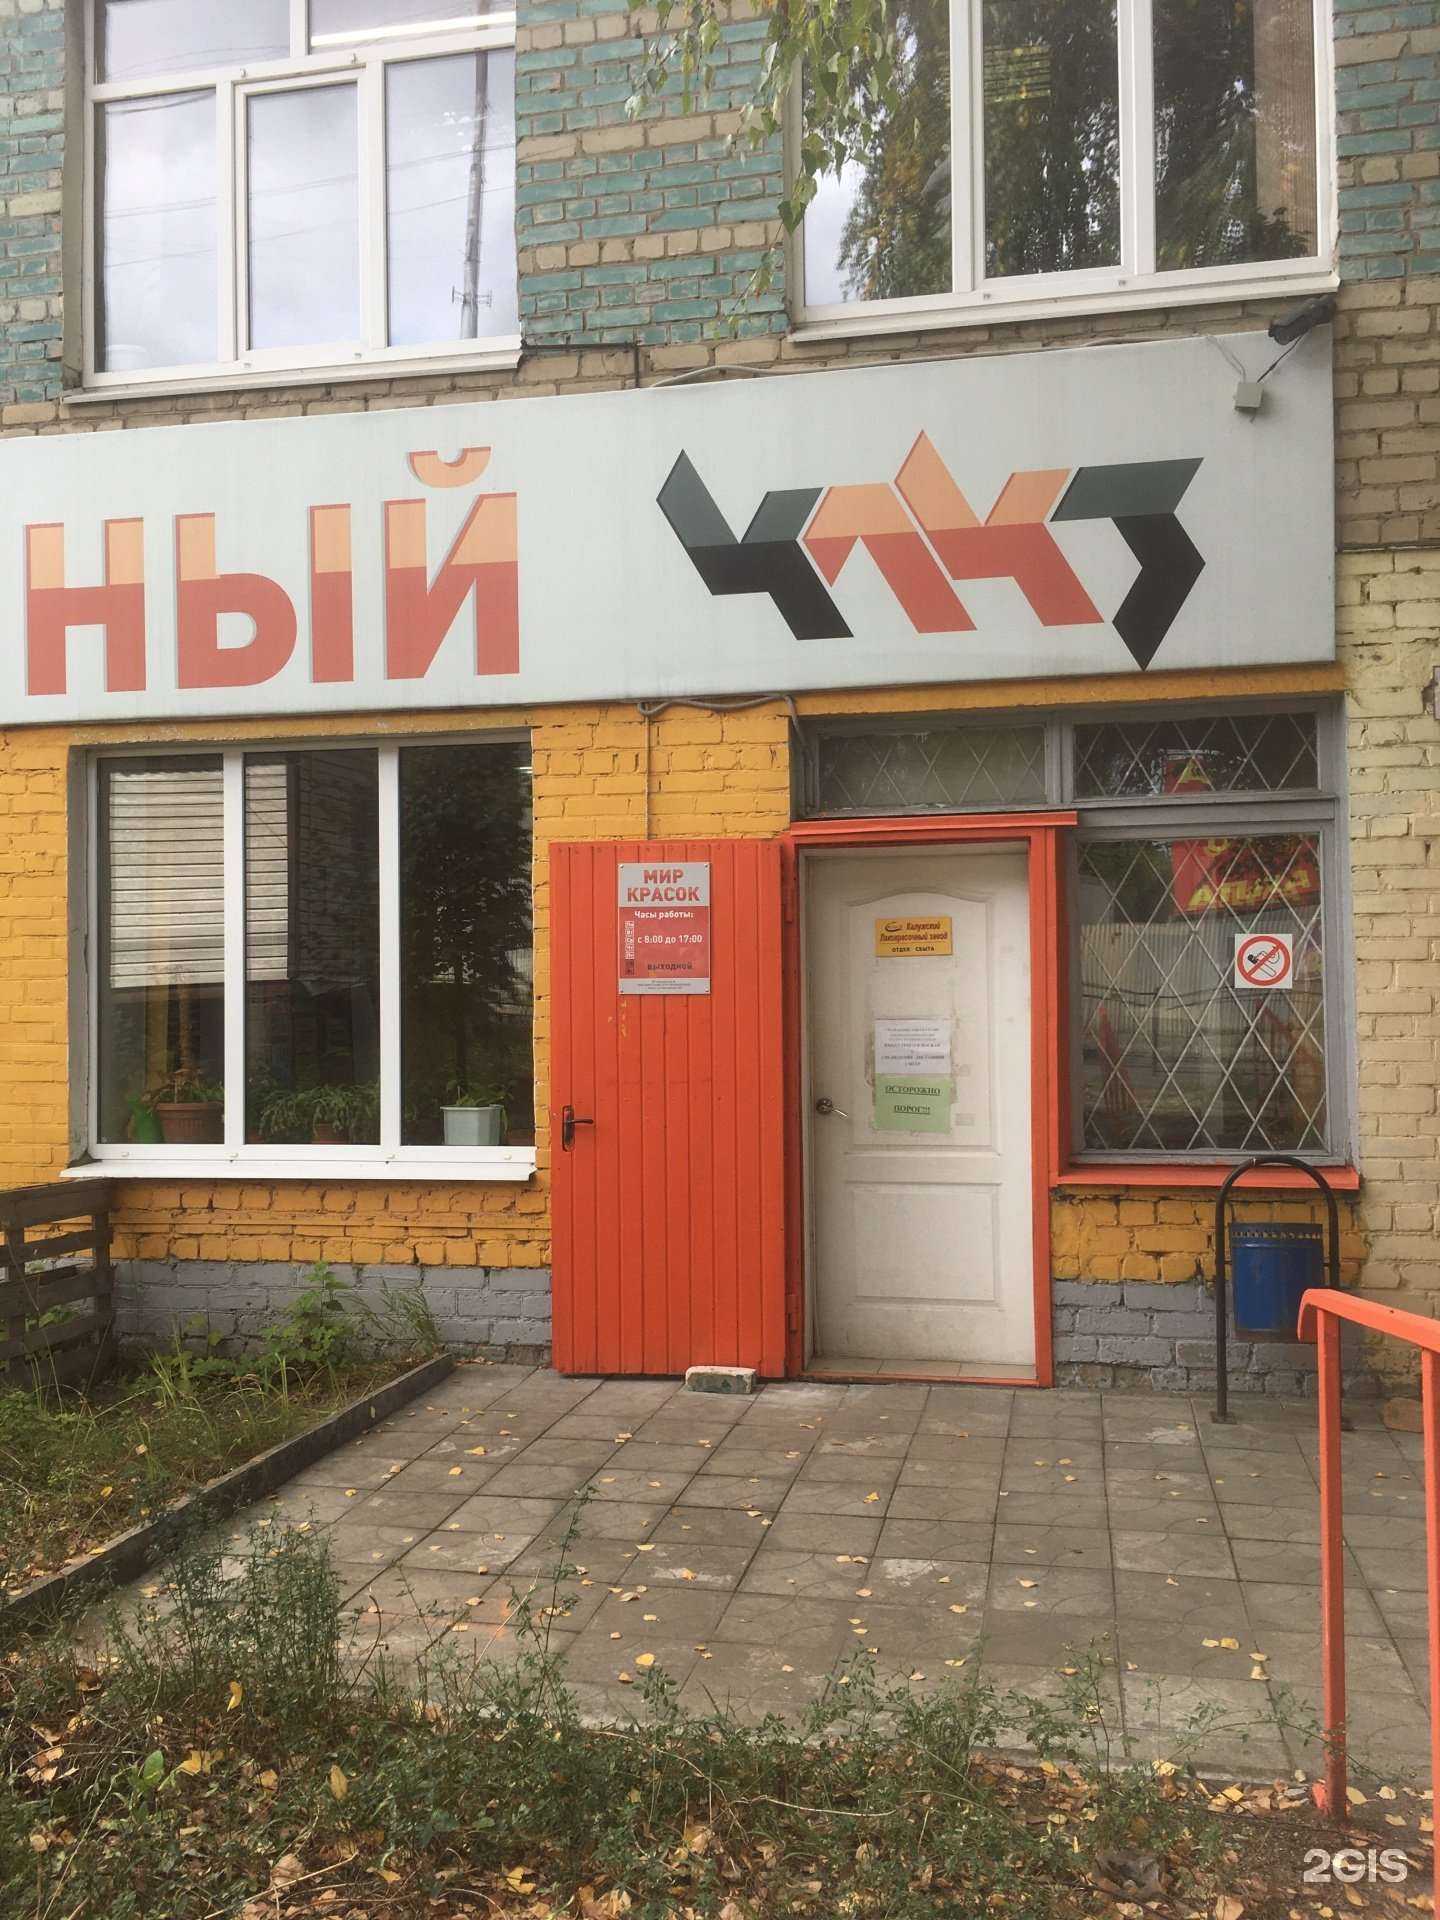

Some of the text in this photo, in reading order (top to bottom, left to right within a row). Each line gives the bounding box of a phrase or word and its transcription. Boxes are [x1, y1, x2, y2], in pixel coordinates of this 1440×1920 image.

[24, 446, 520, 696] НЫЙ
[643, 869, 684, 884] МИР
[627, 886, 700, 902] КРАСОК
[634, 909, 694, 920] Часы работы:
[644, 935, 663, 943] 8:00
[665, 936, 676, 944] до
[679, 934, 703, 943] 17:00
